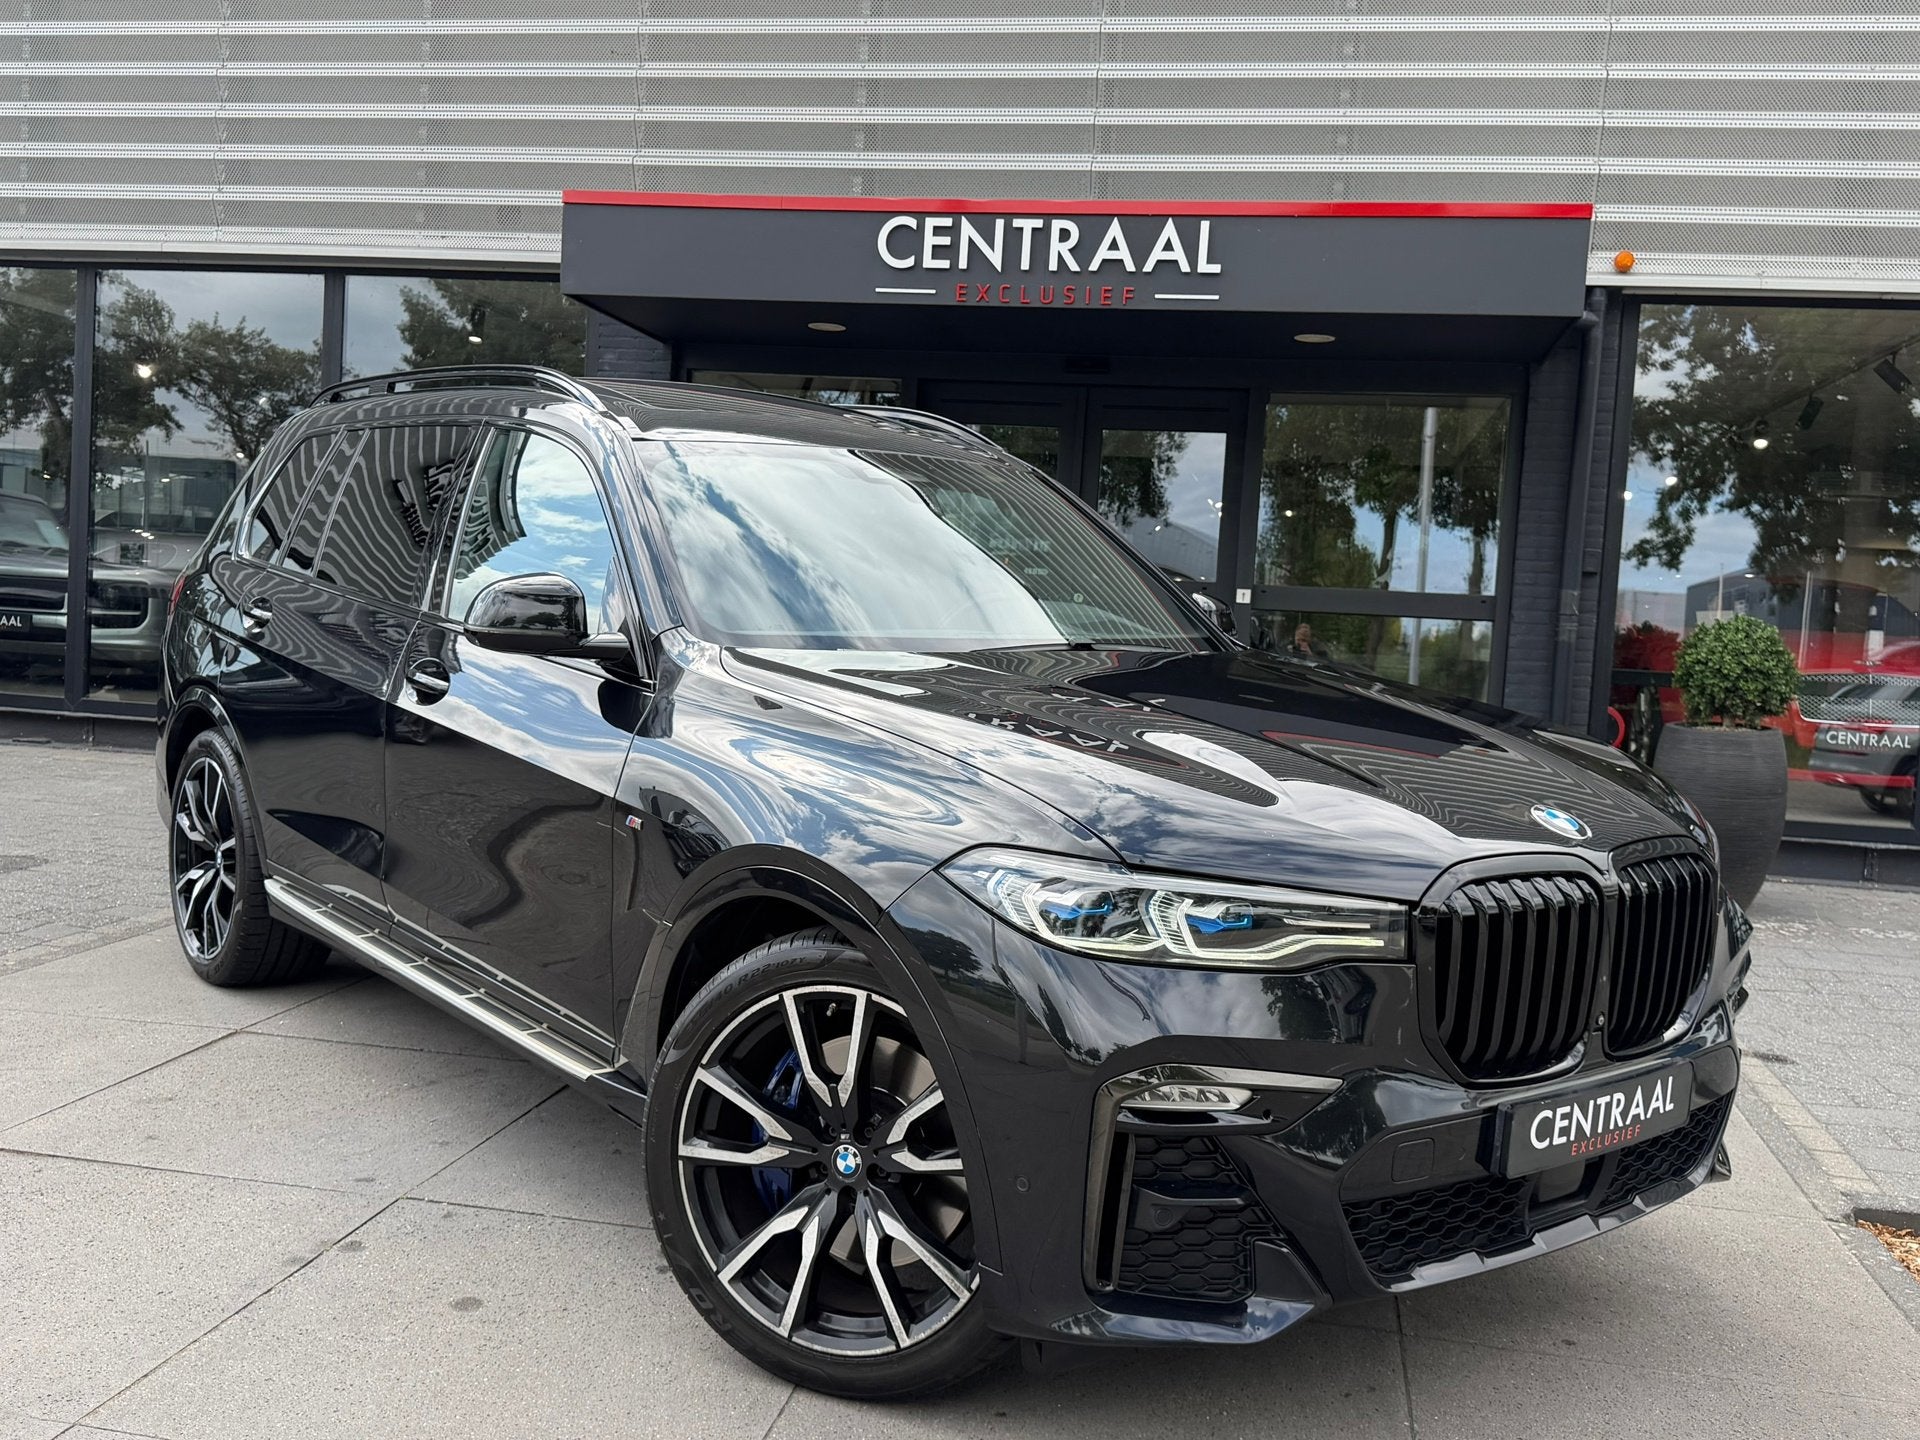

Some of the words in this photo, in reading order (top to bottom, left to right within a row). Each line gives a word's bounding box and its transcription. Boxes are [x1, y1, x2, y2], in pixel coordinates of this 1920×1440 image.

[876, 215, 1222, 274] CENTRAAL
[955, 283, 1136, 306] EXCLUSIEF
[1826, 731, 1911, 749] CENTRAAL
[1530, 1076, 1675, 1150] CENTRAAL
[1571, 1124, 1642, 1156] EXCLUSIEF
